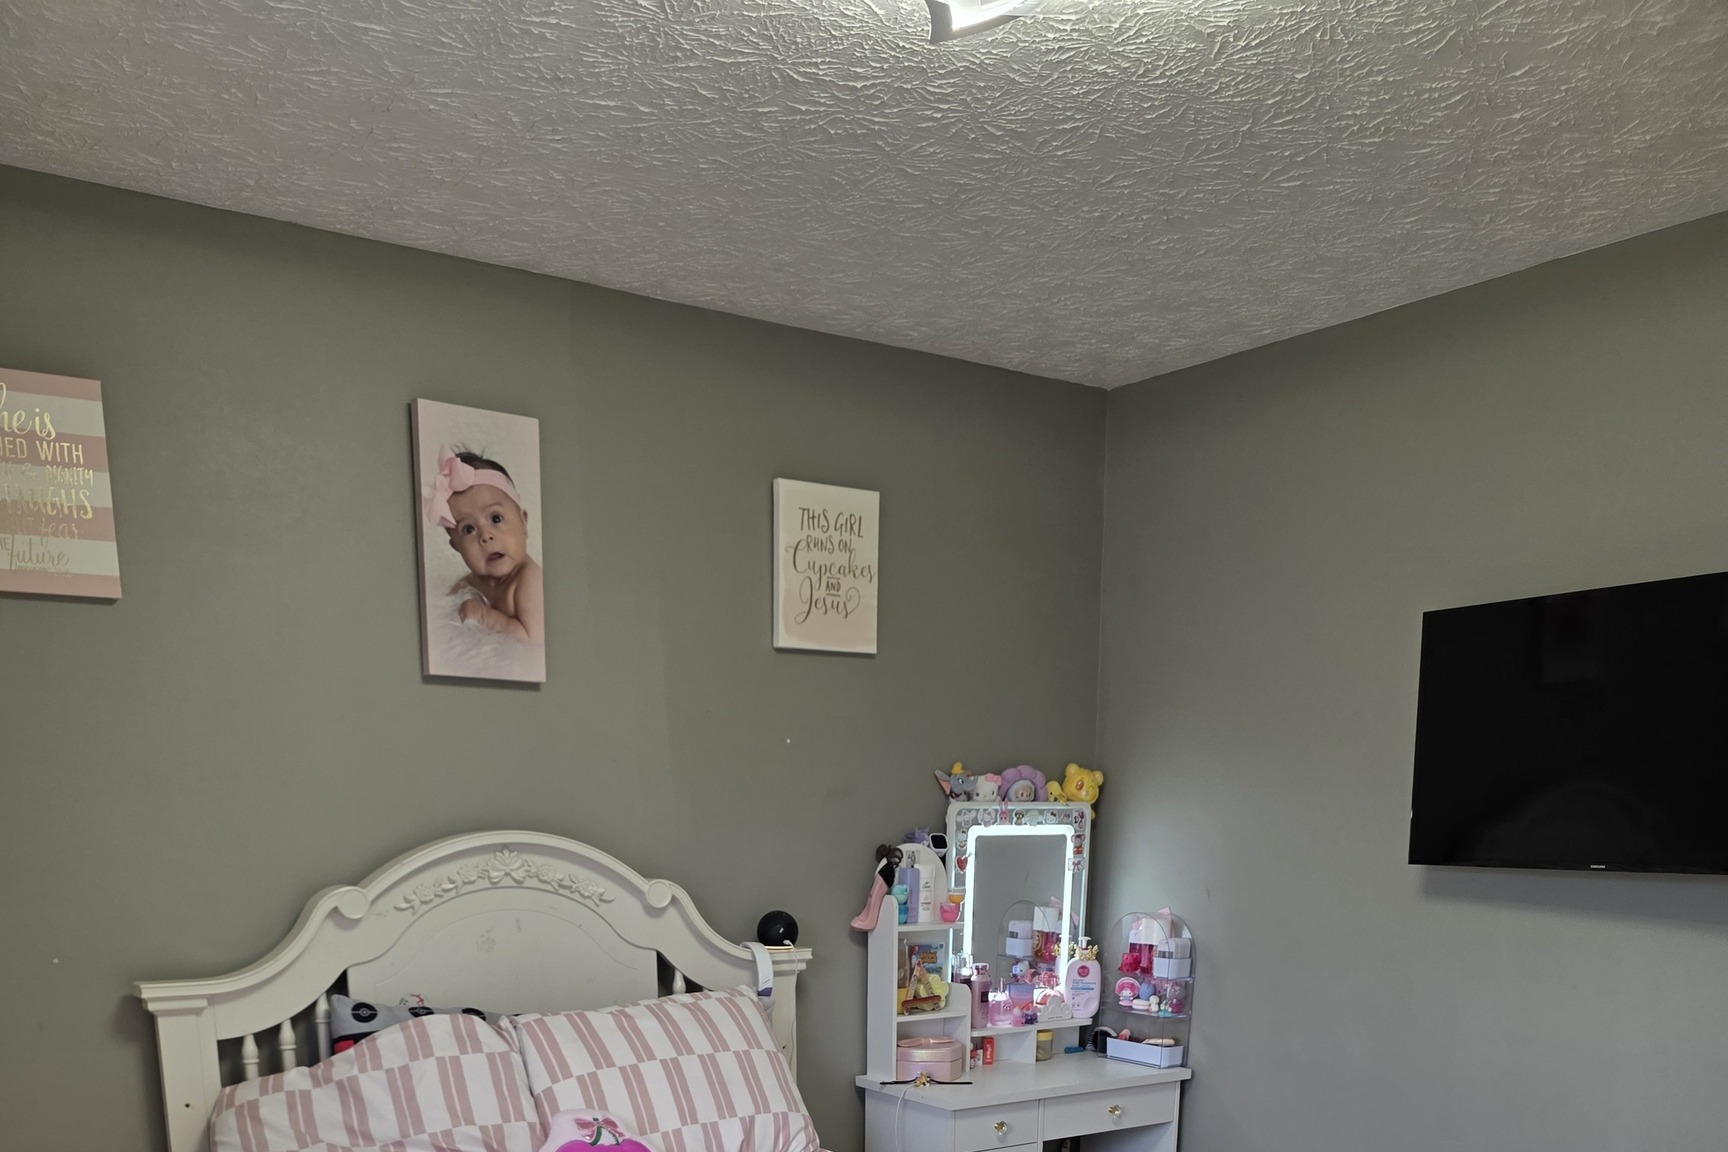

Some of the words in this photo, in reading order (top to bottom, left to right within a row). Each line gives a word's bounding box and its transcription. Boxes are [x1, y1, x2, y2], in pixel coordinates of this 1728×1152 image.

[35, 408, 57, 441] is
[36, 440, 84, 465] WITH
[799, 507, 830, 533] THIS
[834, 512, 864, 538] GIRL
[806, 534, 835, 555] RUNS
[838, 538, 855, 554] ON
[785, 538, 873, 592] Cupcakes
[794, 575, 861, 625] Jesus
[825, 579, 841, 593] AND
